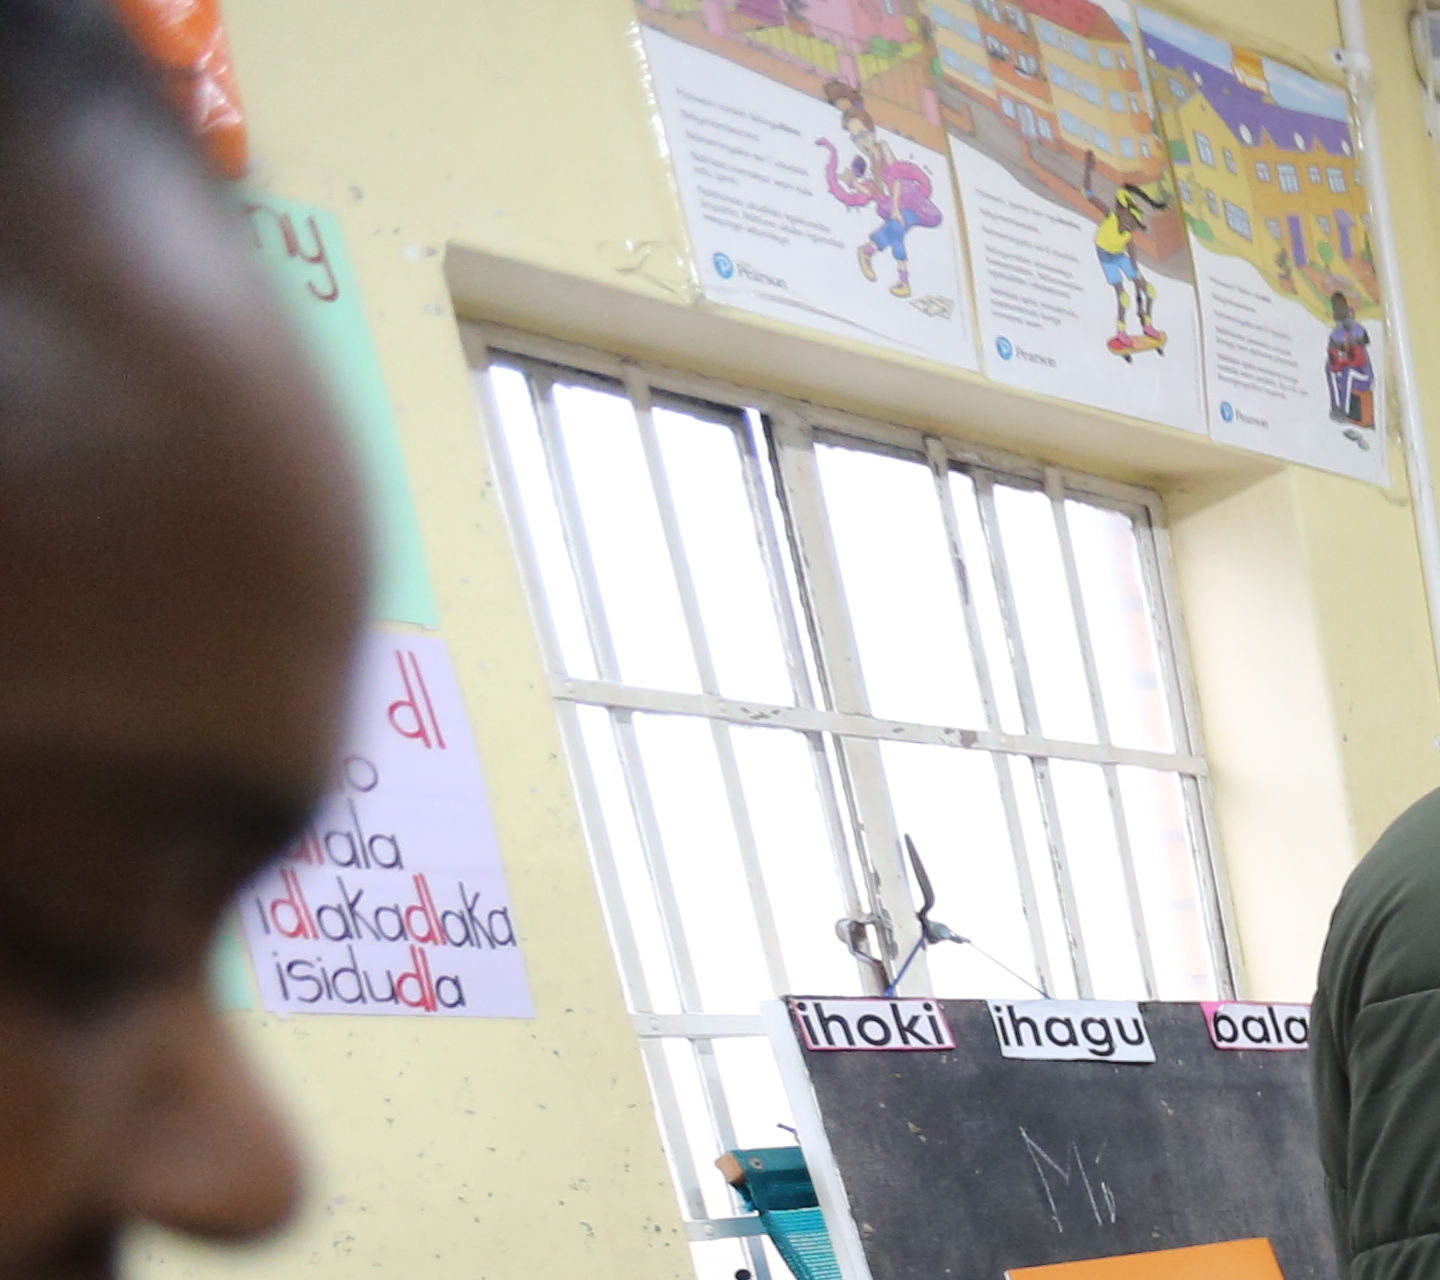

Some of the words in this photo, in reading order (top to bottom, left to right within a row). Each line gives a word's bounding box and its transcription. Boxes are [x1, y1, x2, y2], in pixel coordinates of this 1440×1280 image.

[1015, 345, 1058, 368] Pearson
[272, 943, 466, 1012] isidudla
[797, 1003, 950, 1048] ihoki
[999, 1006, 1144, 1056] ihagu
